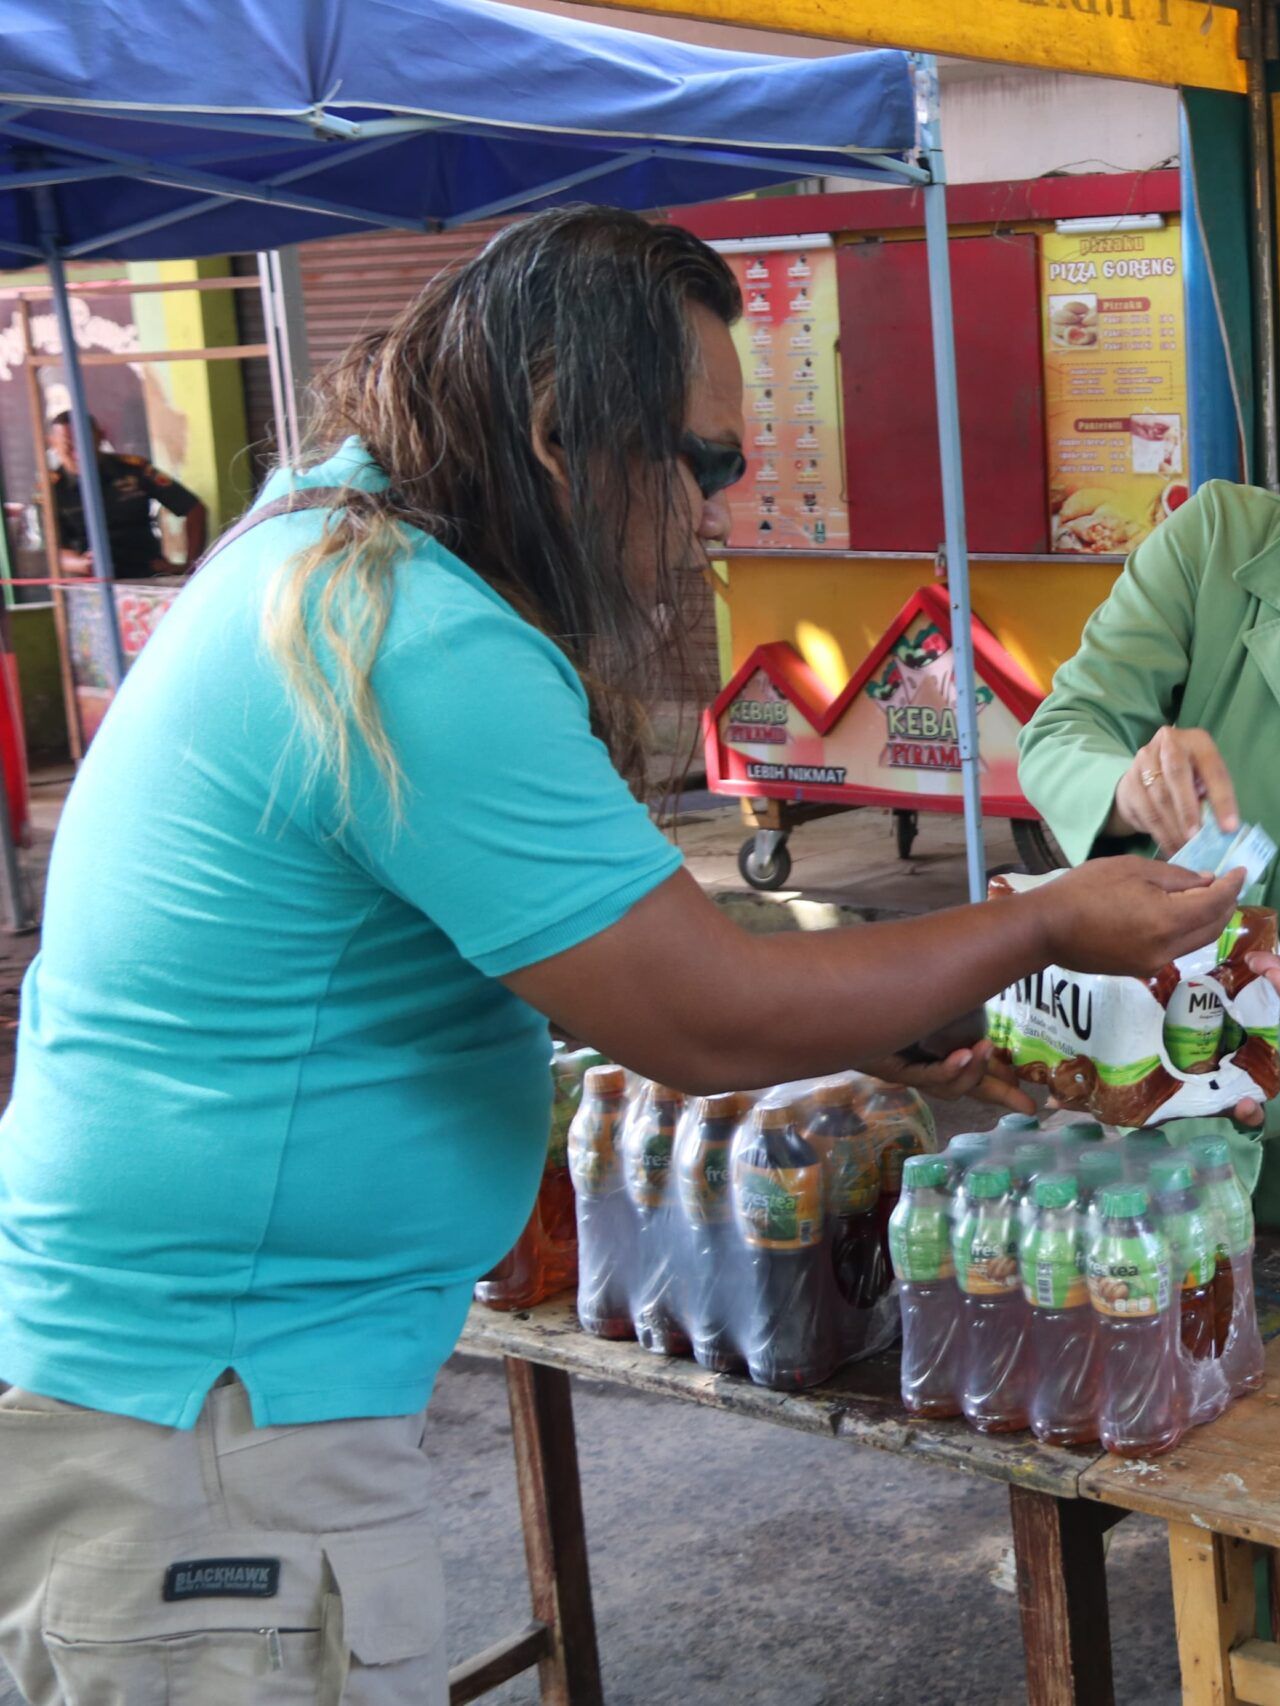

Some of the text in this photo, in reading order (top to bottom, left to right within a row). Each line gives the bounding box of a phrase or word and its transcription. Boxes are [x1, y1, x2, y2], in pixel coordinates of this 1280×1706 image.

[1049, 257, 1175, 284] PIZZA GORENG
[730, 701, 787, 725] KEBAB
[888, 706, 959, 739] KEBA
[748, 763, 846, 785] LEBIH NIKMAT
[1189, 992, 1223, 1013] MIL
[176, 1566, 270, 1585] BLACKHAWK
